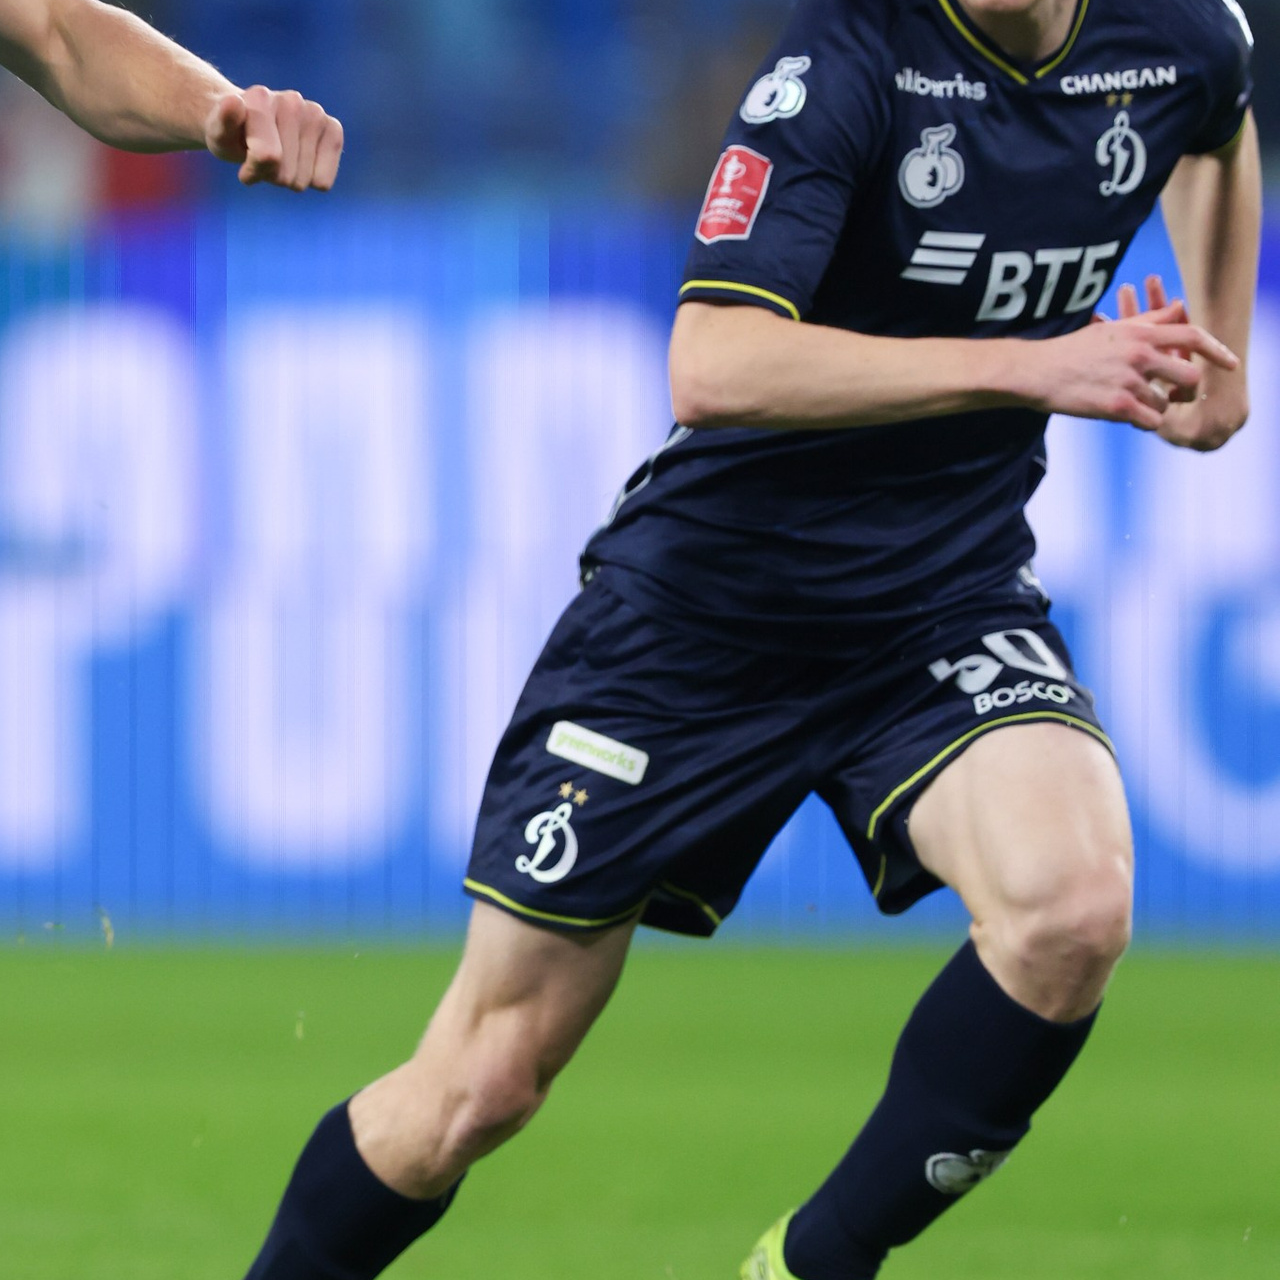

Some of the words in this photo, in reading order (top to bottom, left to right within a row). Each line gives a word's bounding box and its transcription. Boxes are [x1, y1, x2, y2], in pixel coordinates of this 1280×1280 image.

[1060, 65, 1176, 95] CHANGAN
[974, 240, 1120, 321] ВТБ
[973, 680, 1070, 715] BOSCO
